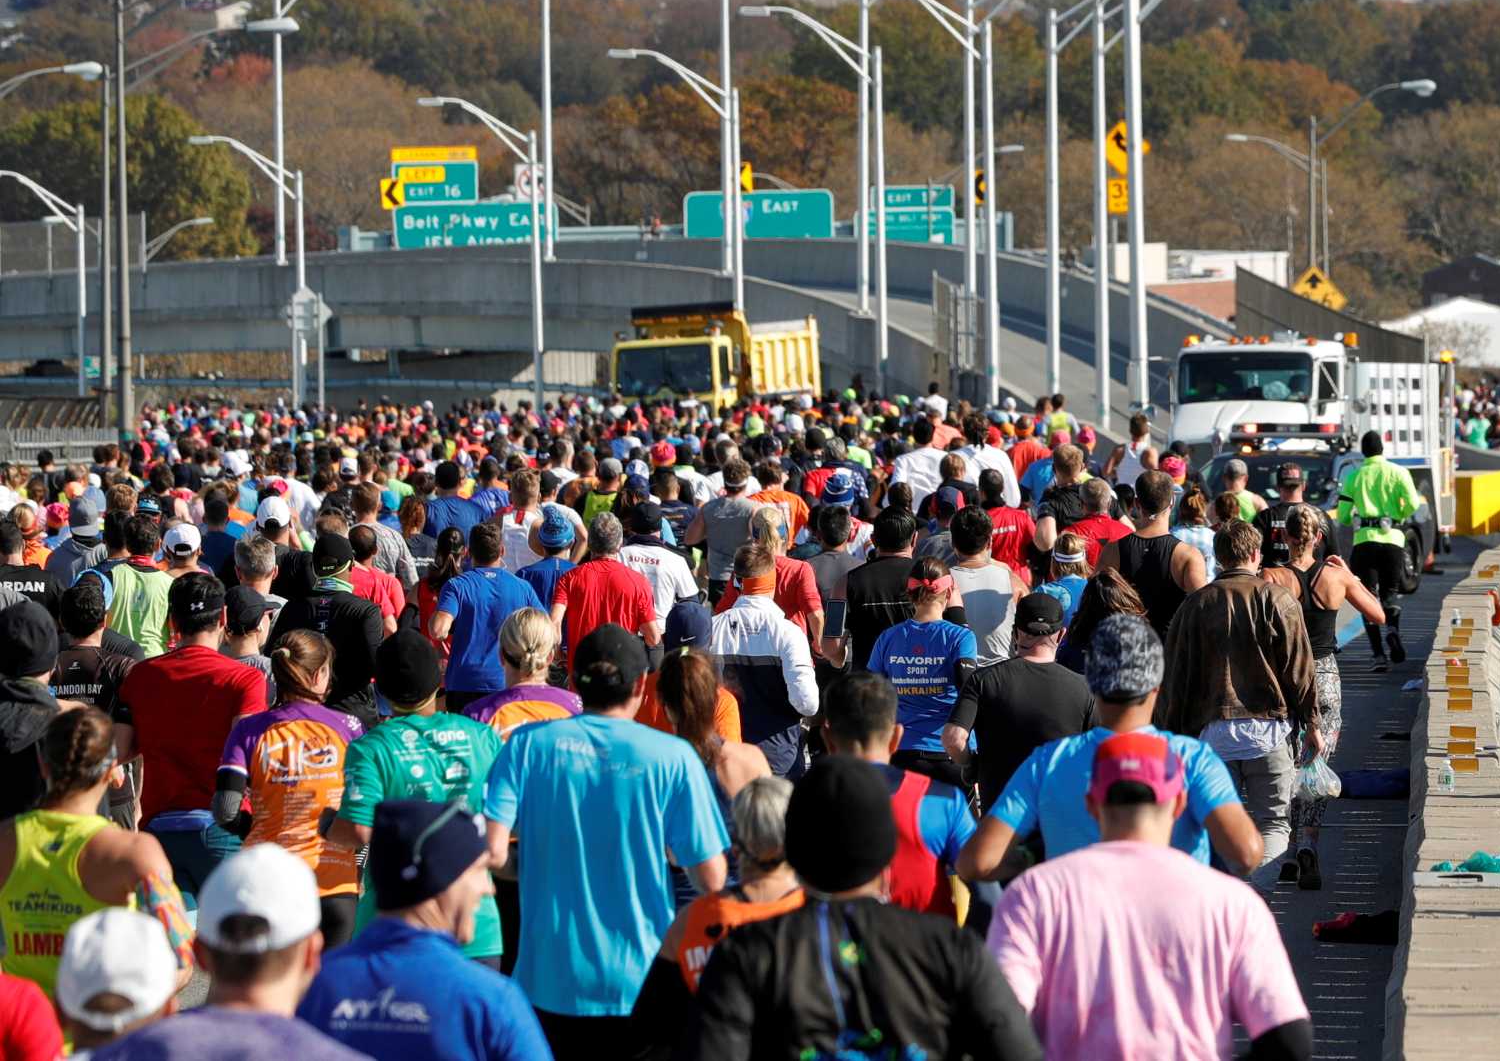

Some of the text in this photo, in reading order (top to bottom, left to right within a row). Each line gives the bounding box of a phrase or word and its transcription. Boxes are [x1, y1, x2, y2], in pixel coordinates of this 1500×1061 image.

[409, 184, 461, 198] EXIT 16
[762, 199, 798, 213] EAST
[403, 214, 439, 230] Belt
[448, 213, 499, 230] Pkwy
[889, 656, 946, 665] FAVORIT
[907, 667, 928, 675] SPORT
[87, 684, 103, 695] BAY
[896, 686, 945, 695] UKRAINE
